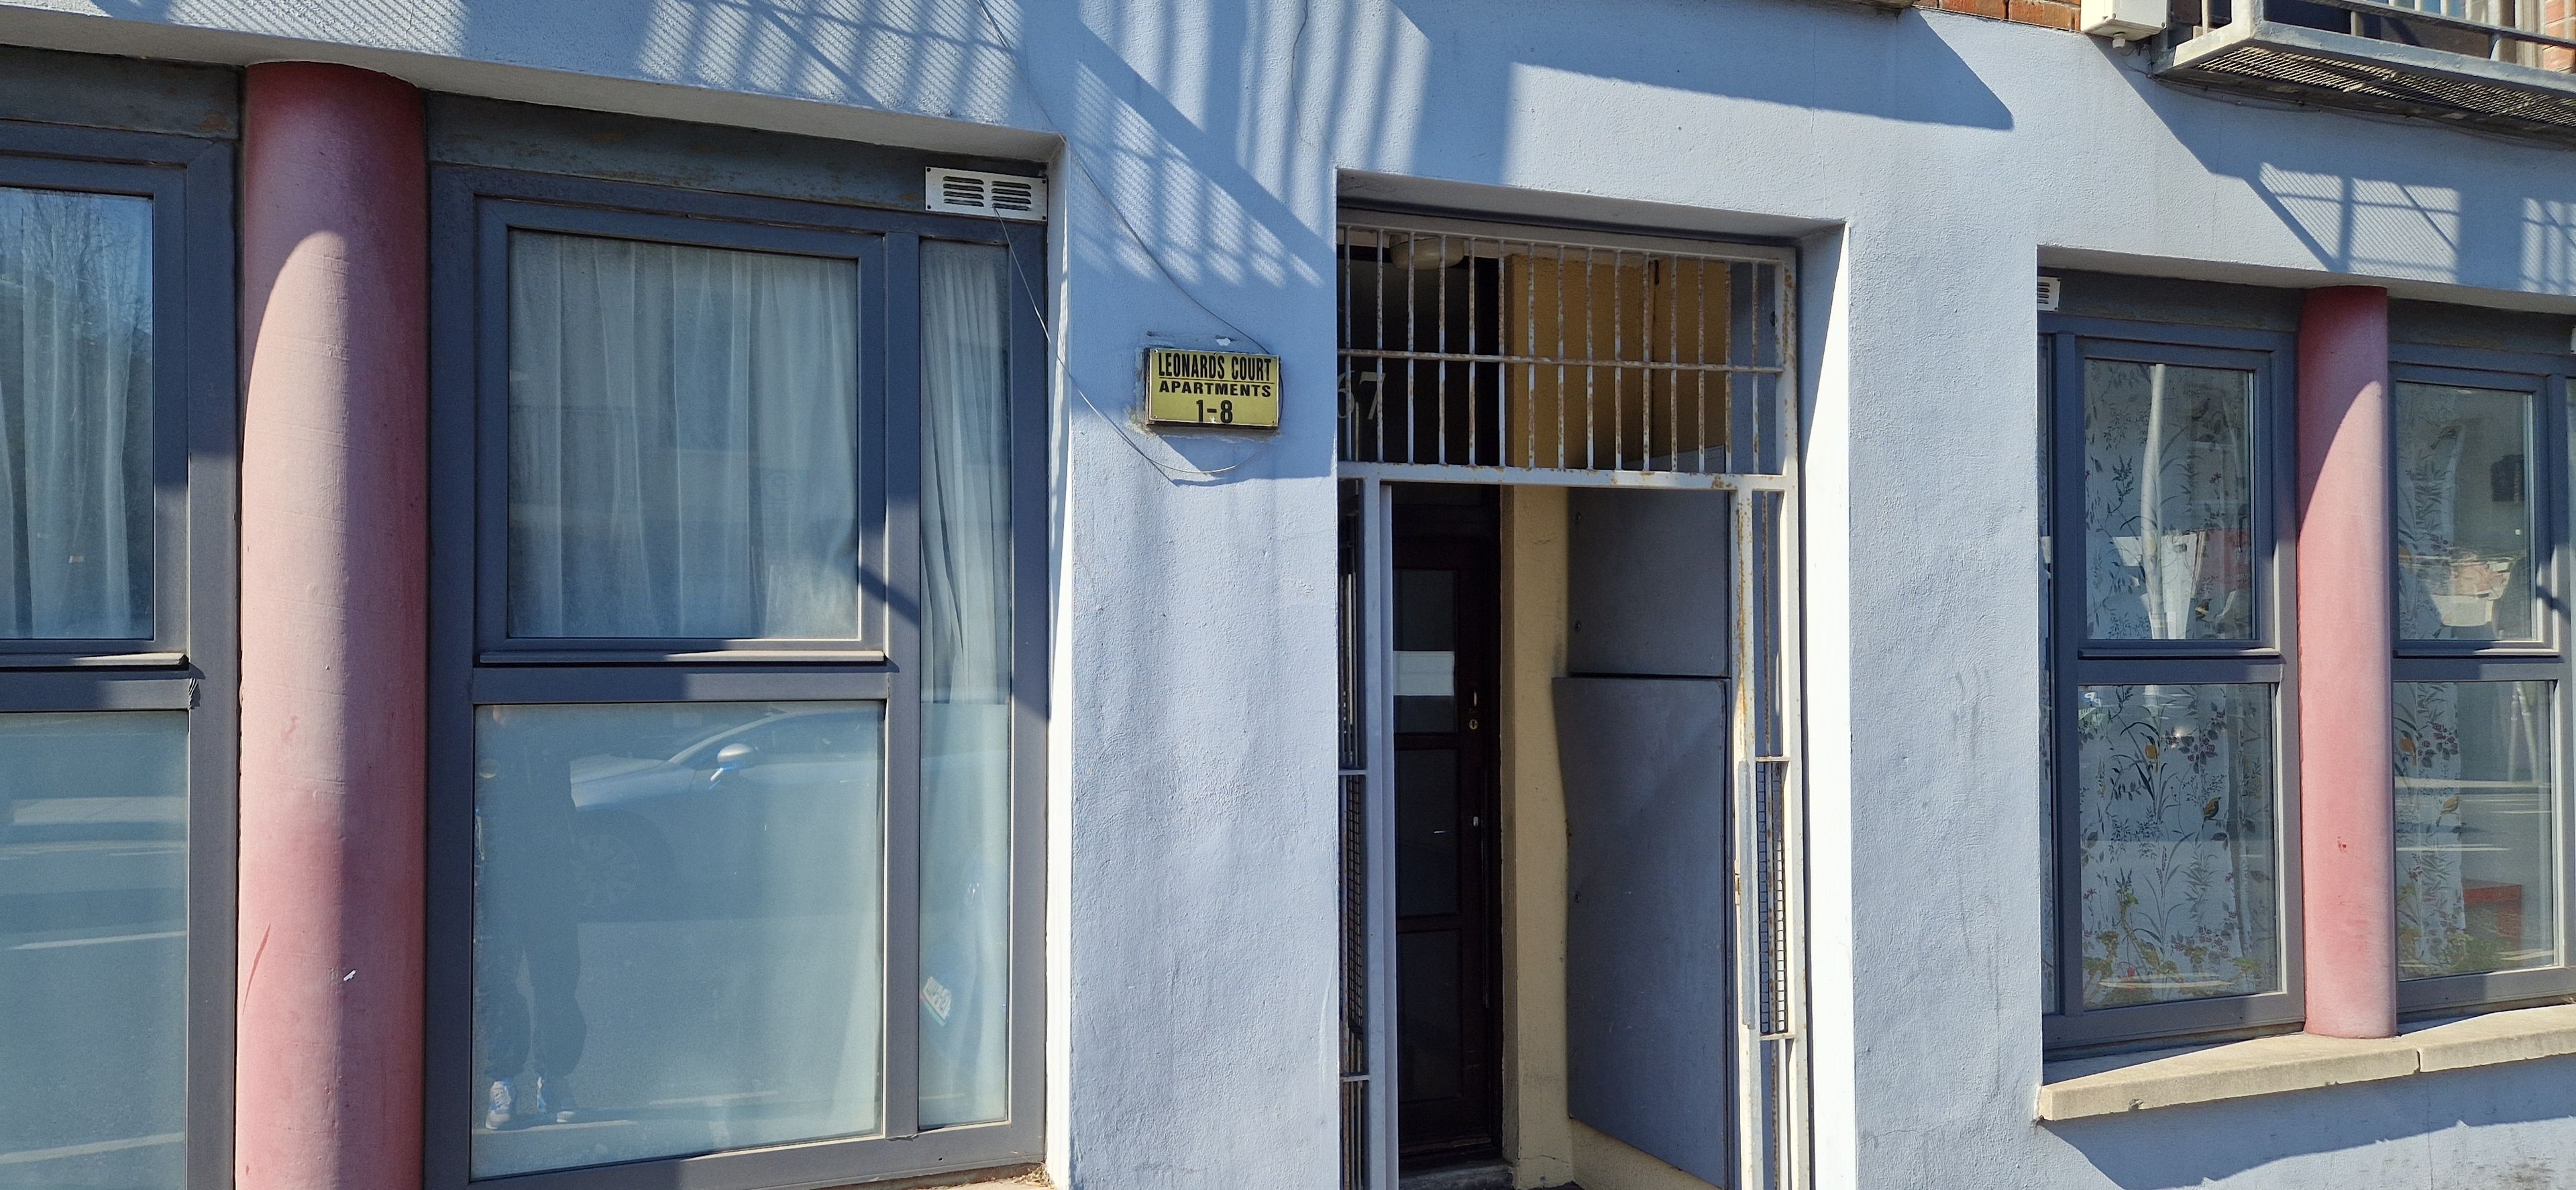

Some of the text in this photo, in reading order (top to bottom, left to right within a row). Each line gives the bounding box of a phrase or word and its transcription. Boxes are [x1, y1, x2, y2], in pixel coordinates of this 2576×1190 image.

[1159, 352, 1272, 381] LEONARDS COURT
[1159, 380, 1272, 398] APARTMENTS
[1337, 370, 1386, 420] 67
[1196, 399, 1233, 424] 1-8
